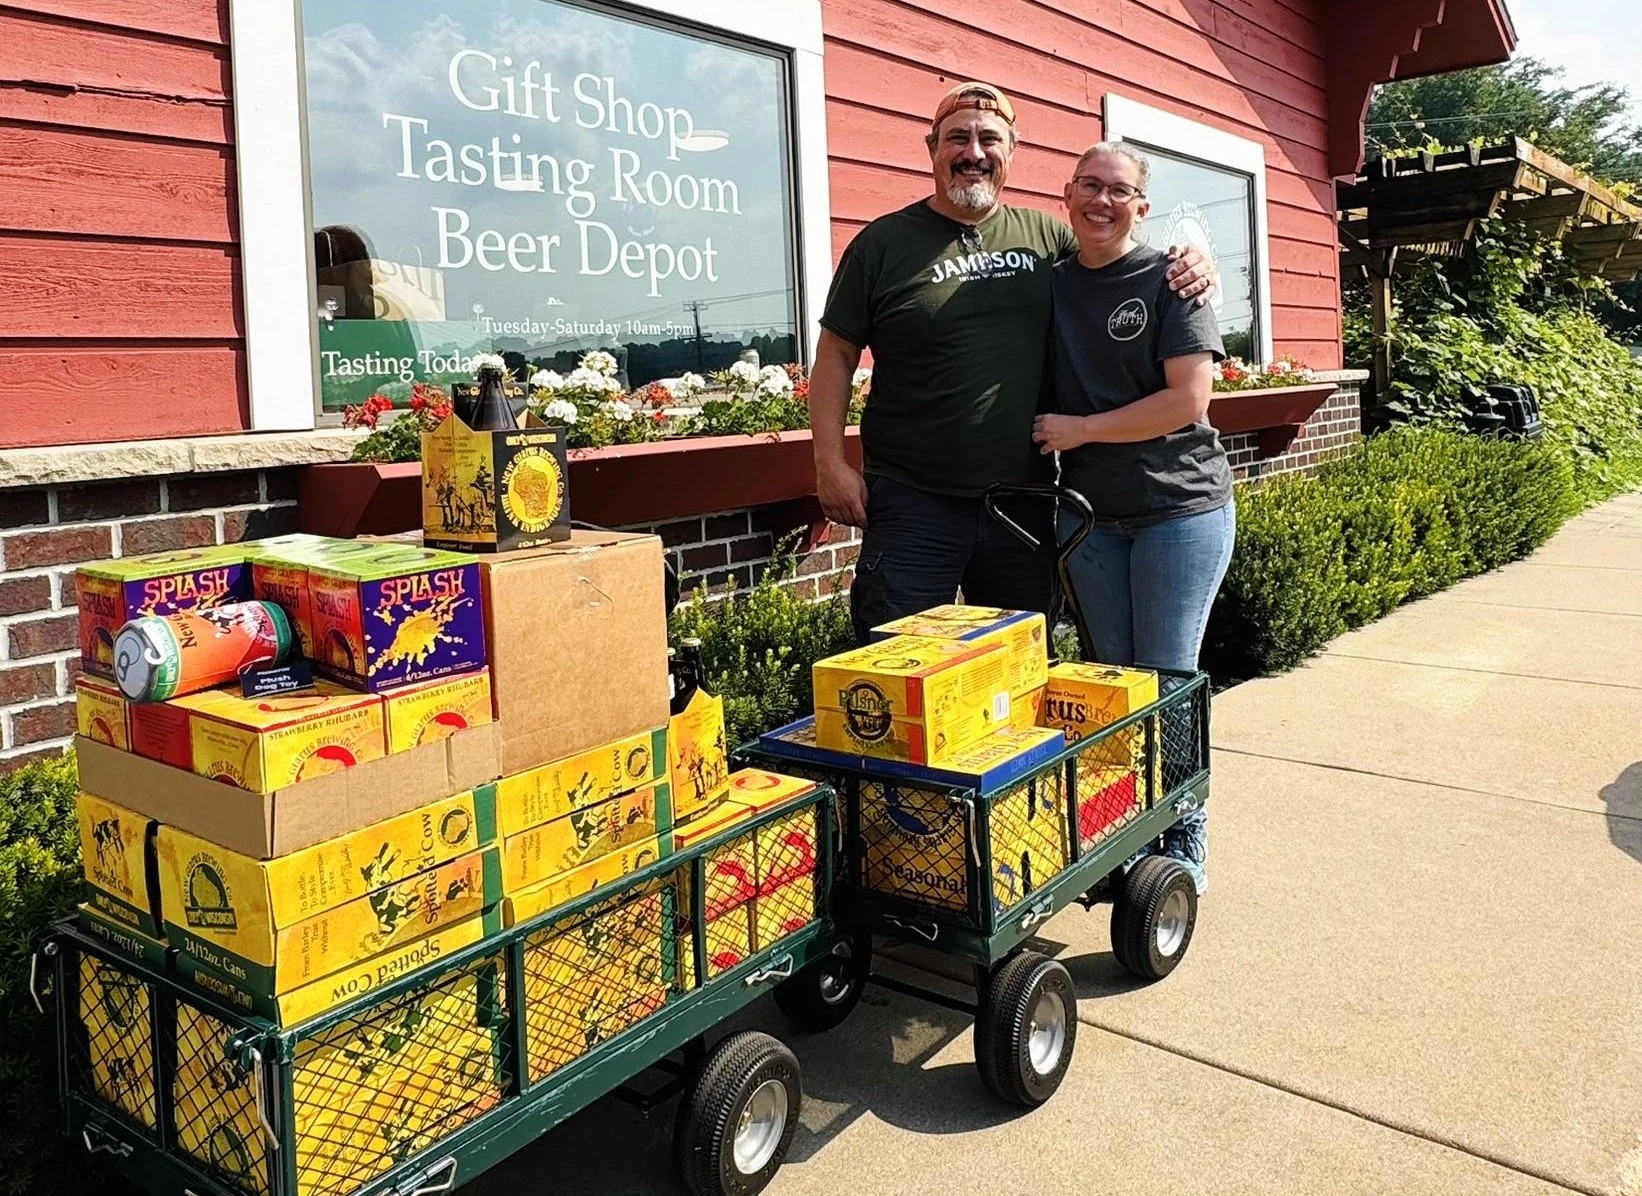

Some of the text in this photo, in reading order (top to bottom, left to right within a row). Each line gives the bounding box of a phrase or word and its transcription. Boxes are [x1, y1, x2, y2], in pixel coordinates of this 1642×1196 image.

[448, 49, 695, 161] Gift Shop
[383, 113, 743, 219] Tasting Room
[431, 207, 560, 274] Beer
[575, 219, 719, 298] Depot
[482, 317, 695, 340] Tuesday-Saturday 10am-5pm
[321, 349, 478, 383] Tasting Toda
[144, 568, 231, 606] SPLASH
[380, 568, 466, 609] SPLASH
[316, 591, 351, 622] SPLASH
[177, 622, 198, 650] New
[254, 680, 299, 691] Dog Toy
[260, 674, 291, 684] Plush
[432, 666, 452, 676] Cans
[398, 676, 484, 706] STRAWBERRY RHUBARB
[838, 689, 893, 714] Pilsner
[269, 721, 324, 741] STRAWBERRY
[325, 709, 370, 729] RHUBARB
[612, 749, 623, 782] Cow
[420, 813, 441, 925] Spotted Cow
[310, 922, 319, 943] True
[321, 919, 329, 956] Without
[184, 937, 247, 981] 24/12oz. Cans
[302, 926, 311, 978] From Barley
[331, 938, 441, 1002] Spotted Cow
